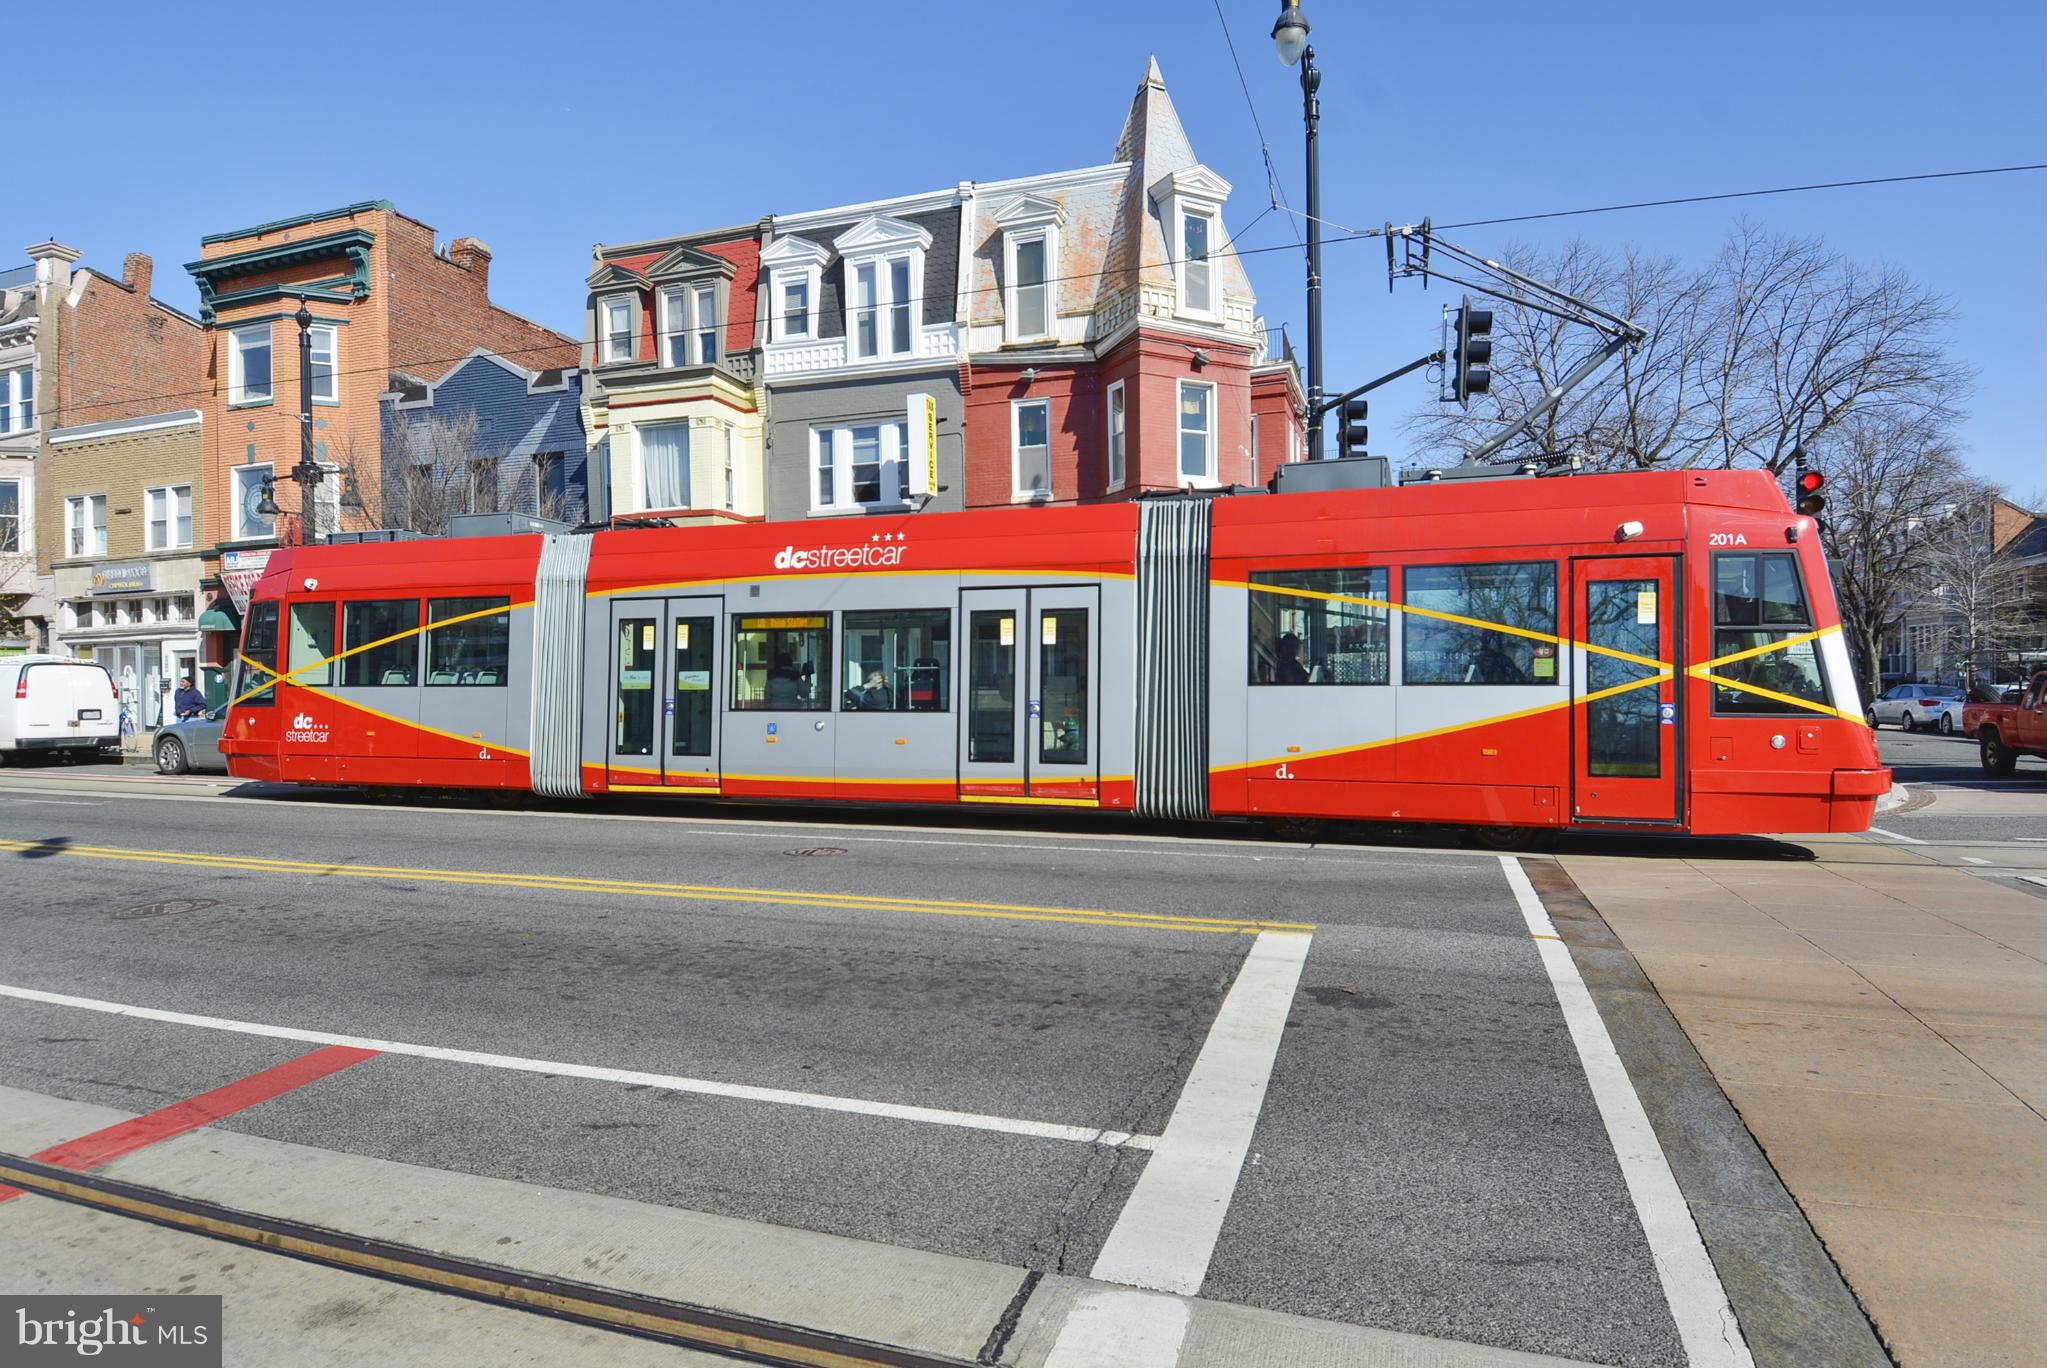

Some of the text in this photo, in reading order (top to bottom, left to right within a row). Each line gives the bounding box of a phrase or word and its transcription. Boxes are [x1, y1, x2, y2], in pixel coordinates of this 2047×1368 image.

[927, 412, 935, 478] SERVICE
[1709, 533, 1747, 545] 201A
[774, 543, 907, 569] dcstreetcar
[285, 729, 329, 743] streetcar
